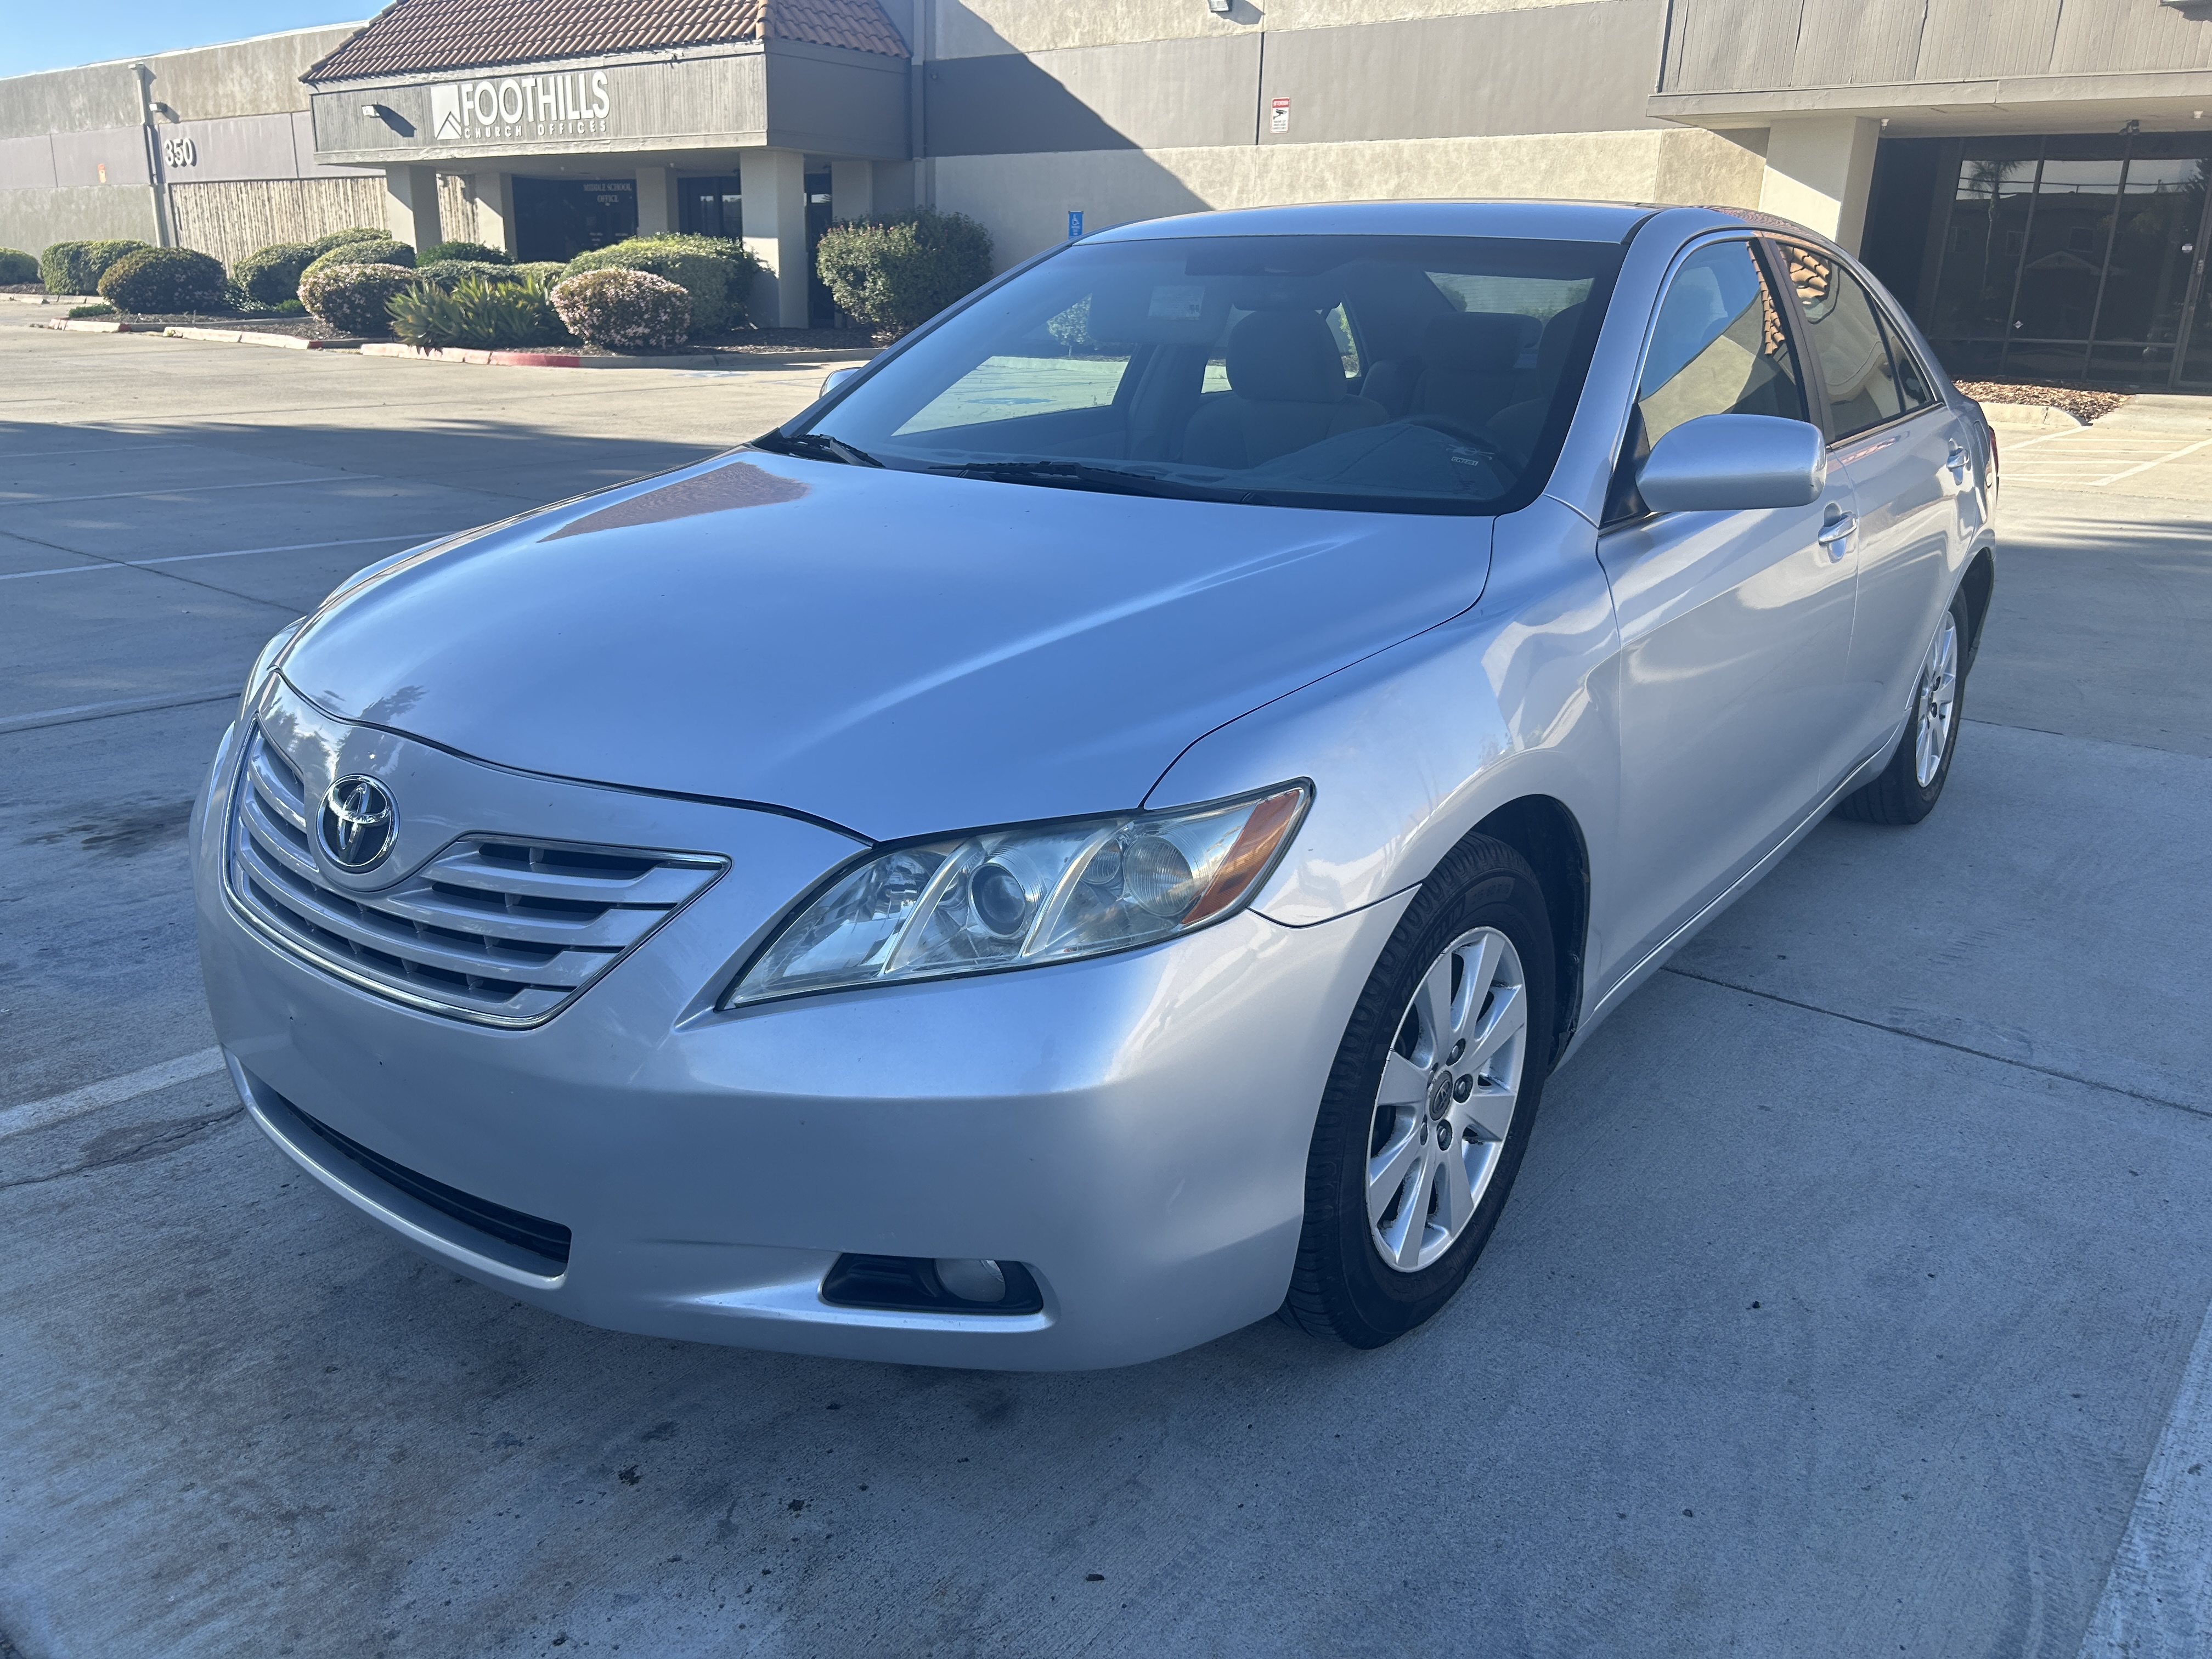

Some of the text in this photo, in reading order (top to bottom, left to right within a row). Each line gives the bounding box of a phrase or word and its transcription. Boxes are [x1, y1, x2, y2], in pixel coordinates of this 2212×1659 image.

[461, 71, 610, 126] FOOTHILLS
[464, 120, 606, 139] CHURCH OFFICES
[164, 137, 193, 166] 350
[1402, 899, 1463, 1003] MICHELIN
